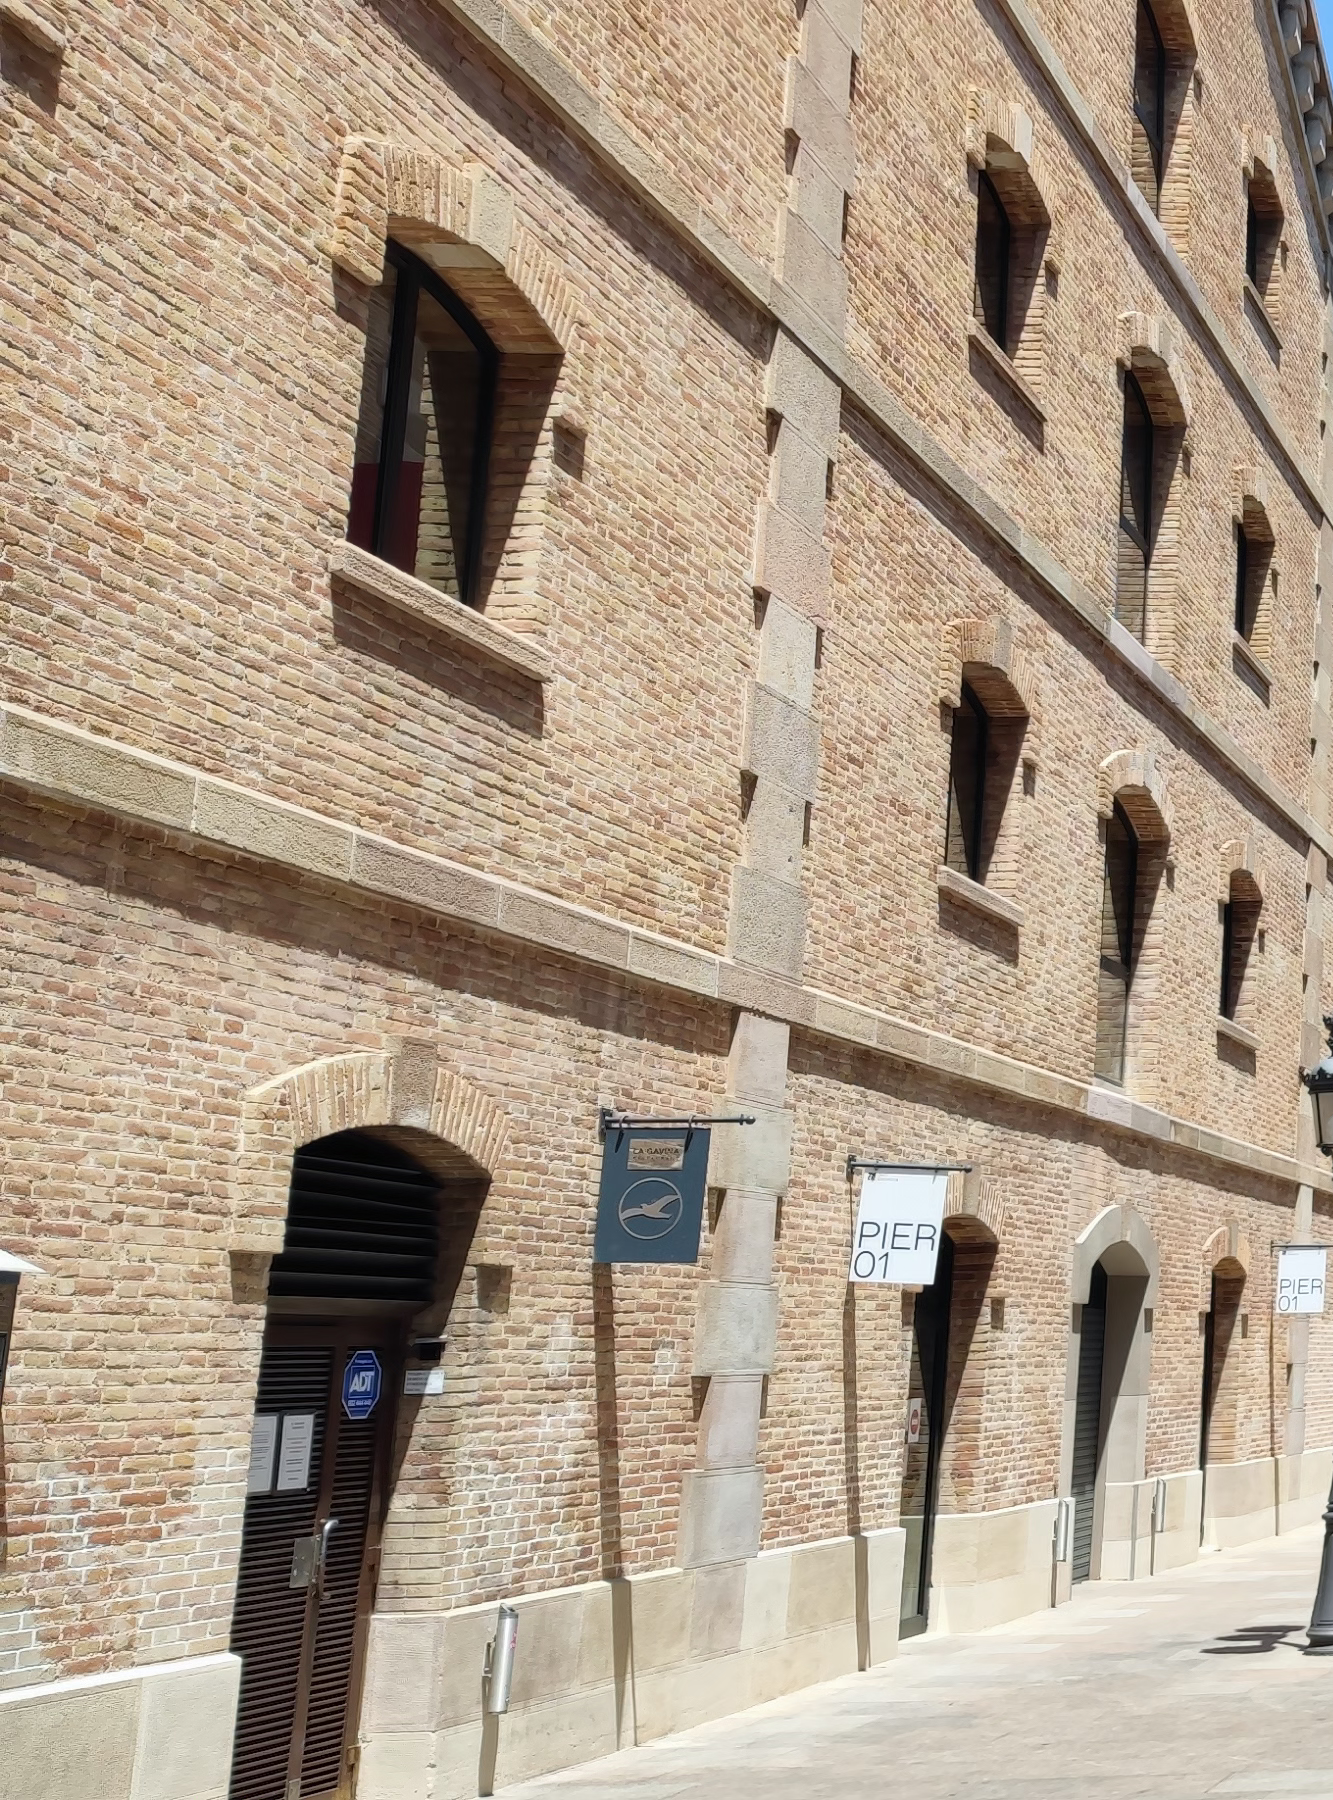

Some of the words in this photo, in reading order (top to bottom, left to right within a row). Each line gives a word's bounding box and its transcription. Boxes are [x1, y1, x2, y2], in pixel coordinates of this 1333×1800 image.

[858, 1221, 937, 1251] PIER
[854, 1251, 889, 1279] 01
[1279, 1278, 1324, 1295] PIER
[1278, 1295, 1298, 1311] 01
[349, 1371, 375, 1393] ADT
